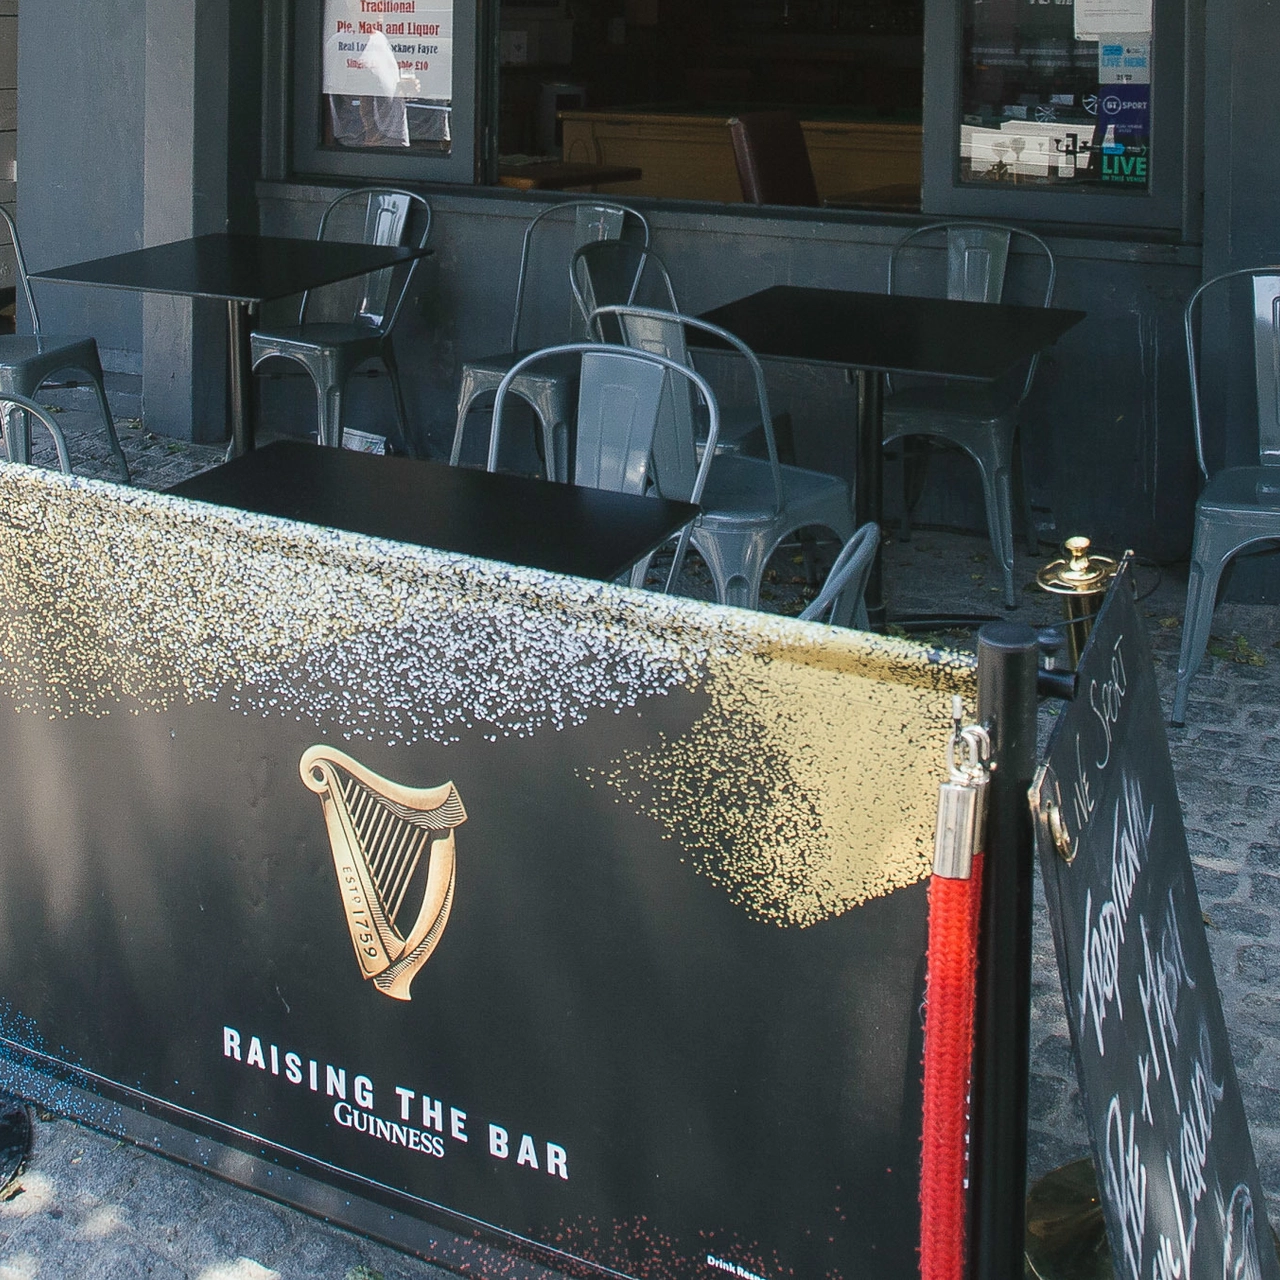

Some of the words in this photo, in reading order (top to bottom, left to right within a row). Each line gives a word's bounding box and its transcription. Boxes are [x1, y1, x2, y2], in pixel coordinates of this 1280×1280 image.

[385, 22, 405, 35] and
[407, 22, 440, 37] Liquor
[338, 41, 355, 51] Real
[418, 43, 438, 54] Fayre
[414, 61, 429, 71] £10
[1122, 101, 1148, 110] SPORT
[1102, 155, 1147, 176] LIVE
[352, 910, 379, 958] 1759
[223, 1026, 374, 1110] RAISING
[394, 1086, 469, 1143] THE
[487, 1123, 569, 1181] BAR
[333, 1101, 445, 1158] GUINNESS
[707, 1255, 736, 1275] Drink
